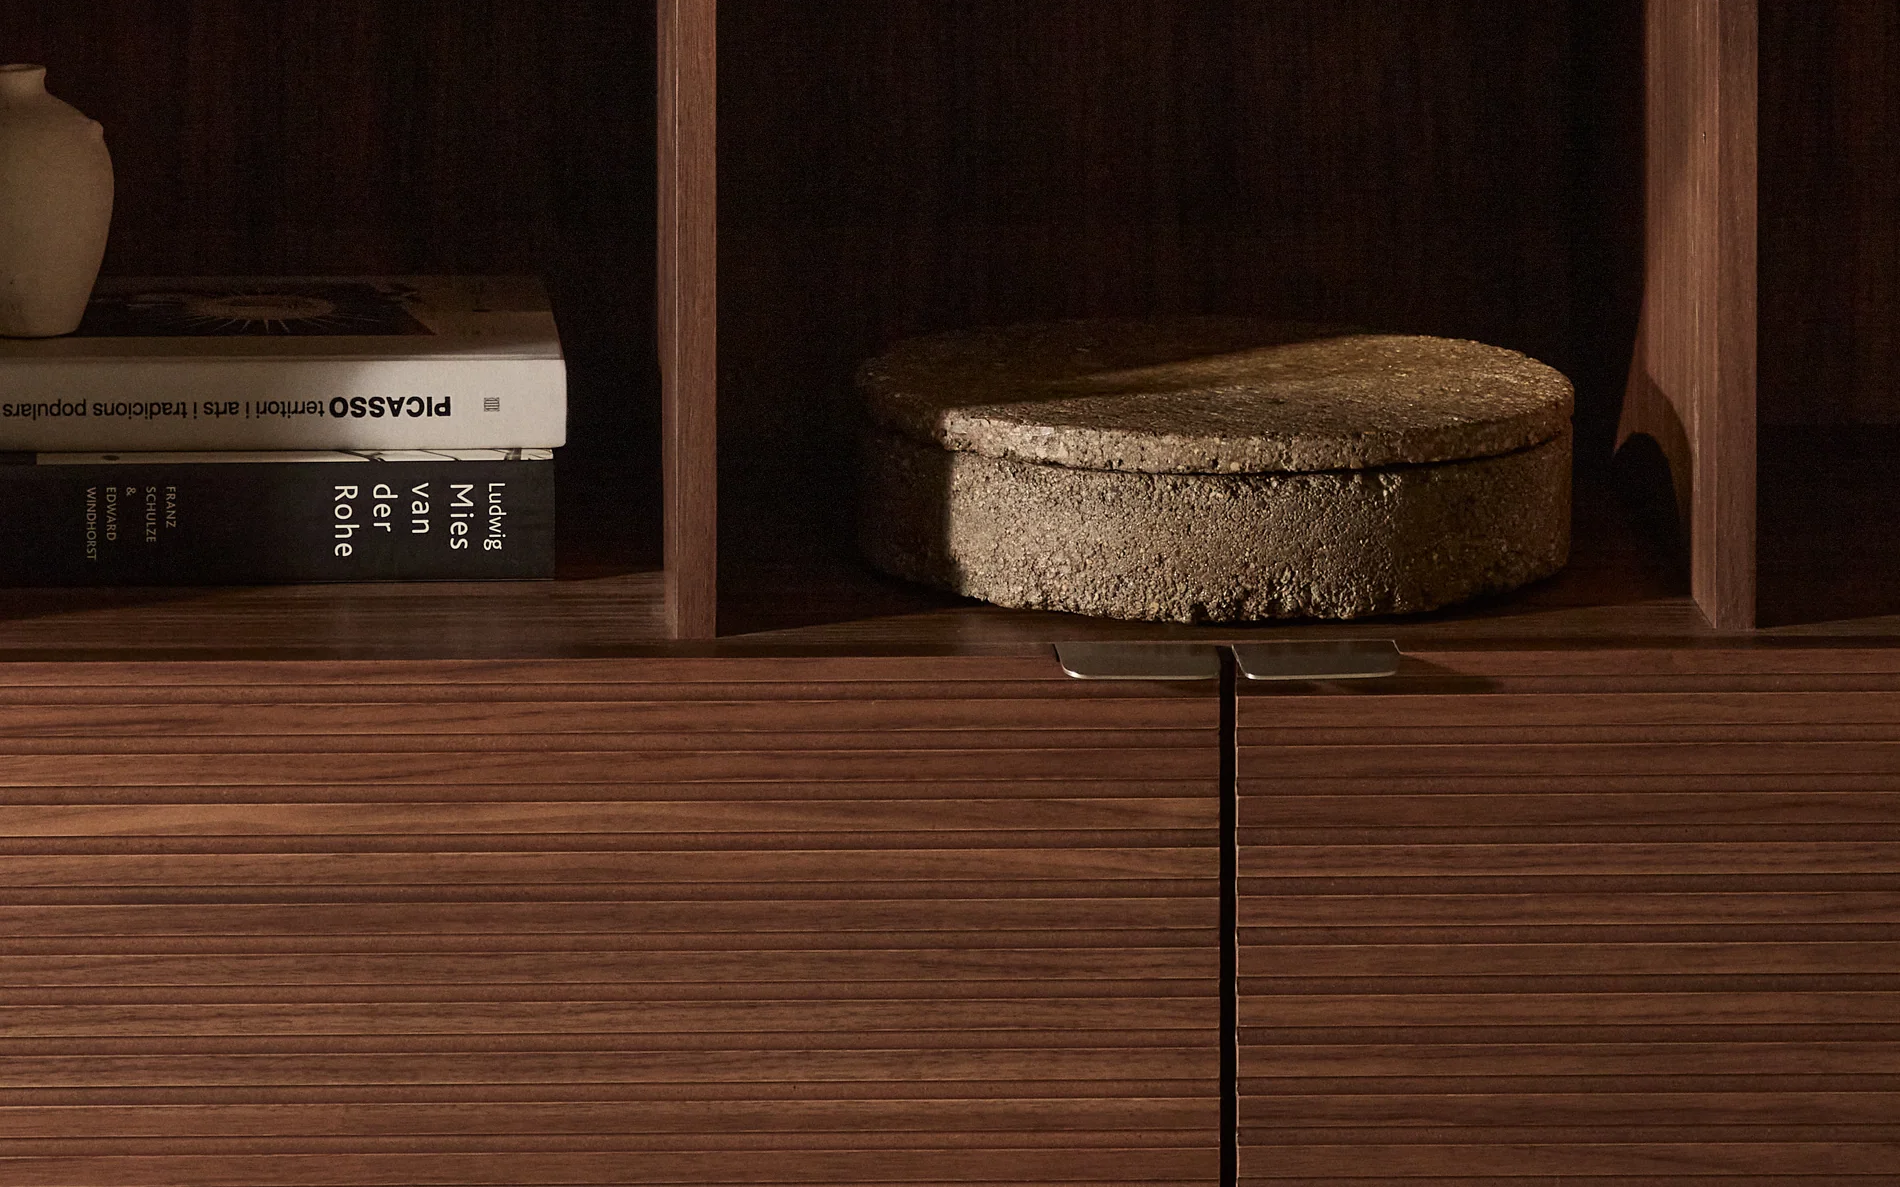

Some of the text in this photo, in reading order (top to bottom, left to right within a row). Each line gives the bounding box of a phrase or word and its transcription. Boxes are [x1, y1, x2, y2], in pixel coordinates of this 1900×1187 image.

[2, 396, 451, 420] PICASSO territori i arts i tradicions populars
[106, 486, 117, 542] EDWARD
[126, 486, 137, 497] &
[146, 486, 157, 544] SCHULZE
[165, 486, 176, 529] FRANZ
[372, 483, 399, 532] der
[411, 483, 430, 535] van
[450, 484, 474, 550] Mies
[484, 482, 507, 551] Ludwig
[86, 486, 97, 561] WINDHORST
[334, 484, 359, 557] Rohe
